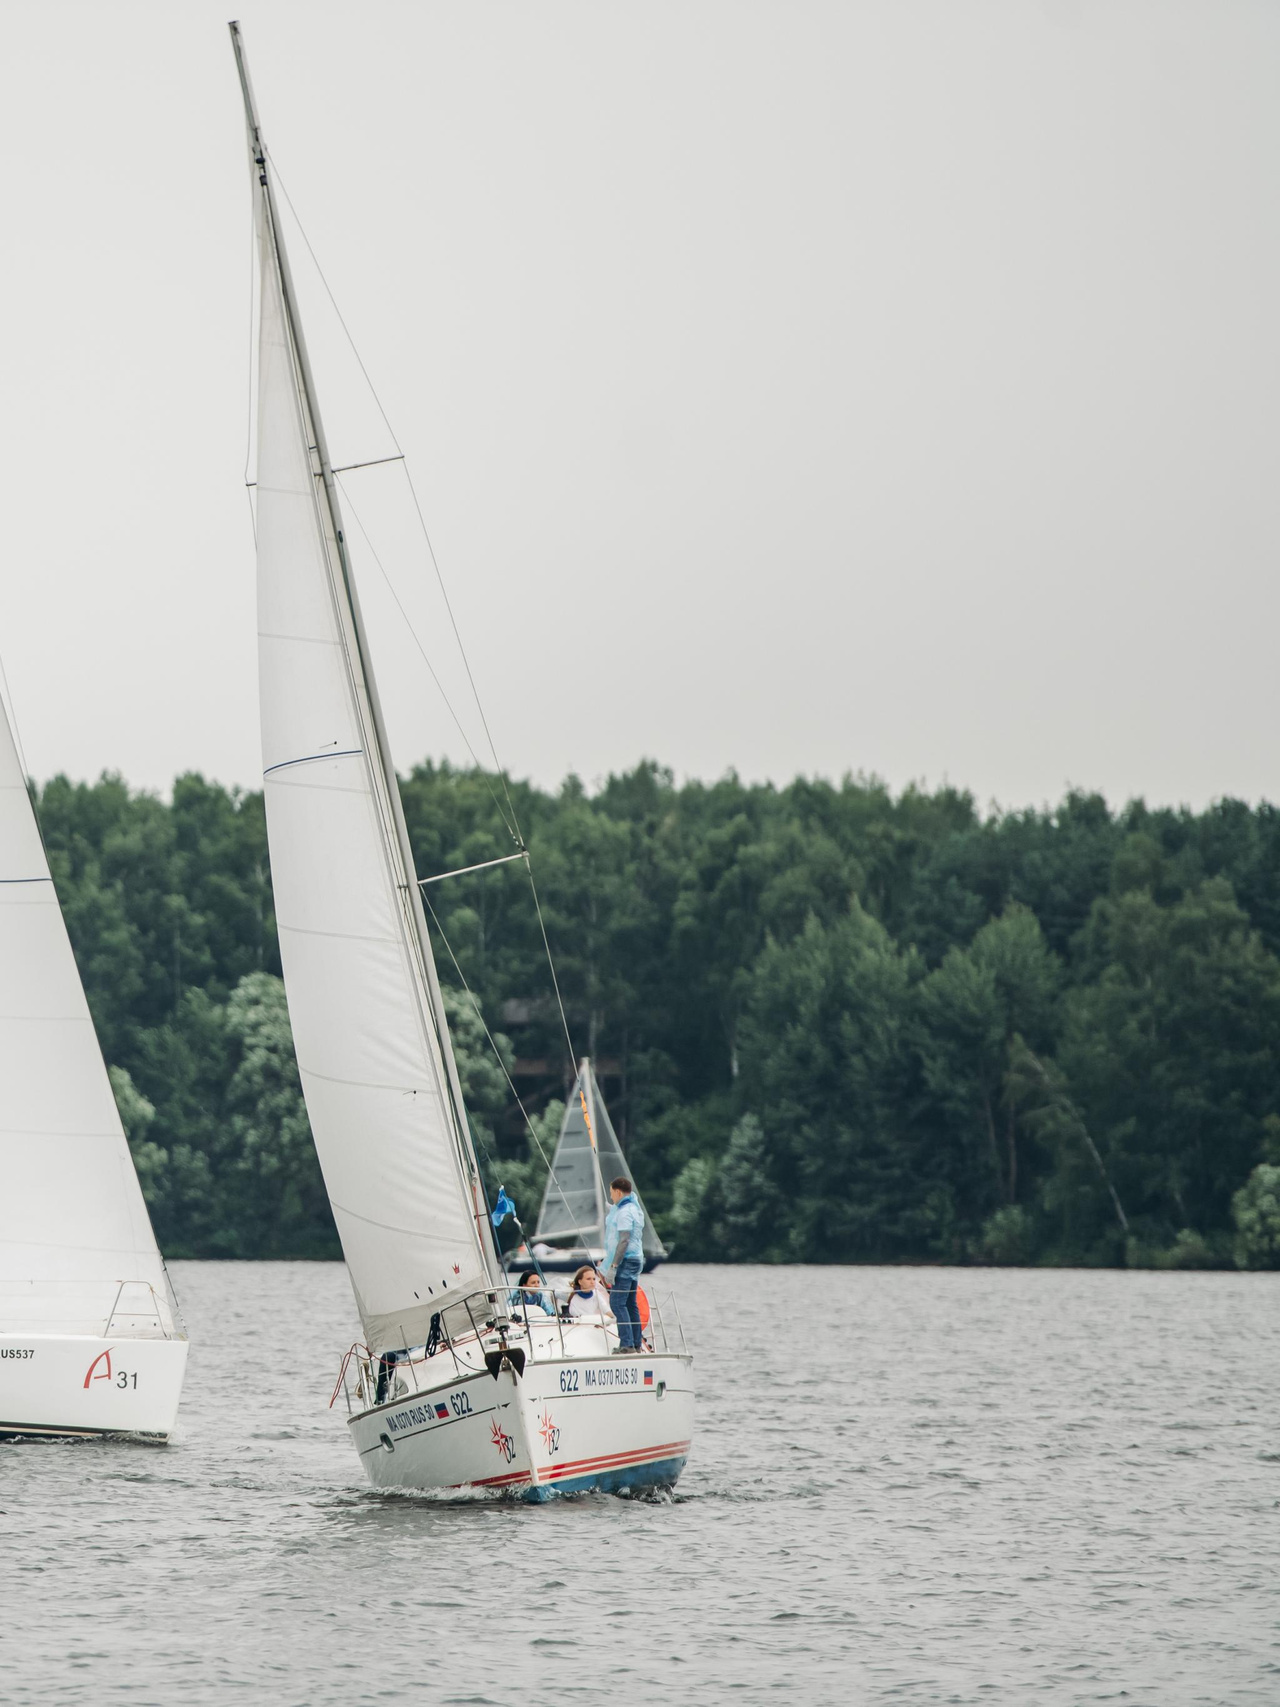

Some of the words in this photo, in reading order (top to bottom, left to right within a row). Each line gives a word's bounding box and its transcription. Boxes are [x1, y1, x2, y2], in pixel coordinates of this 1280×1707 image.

[116, 1371, 138, 1390] 31
[560, 1369, 579, 1392] 622
[585, 1370, 596, 1386] MA
[598, 1369, 613, 1386] 0370
[615, 1368, 629, 1385] RUS
[630, 1368, 638, 1384] 50
[409, 1406, 427, 1424] RUS
[424, 1403, 436, 1420] 50
[450, 1391, 473, 1416] 622
